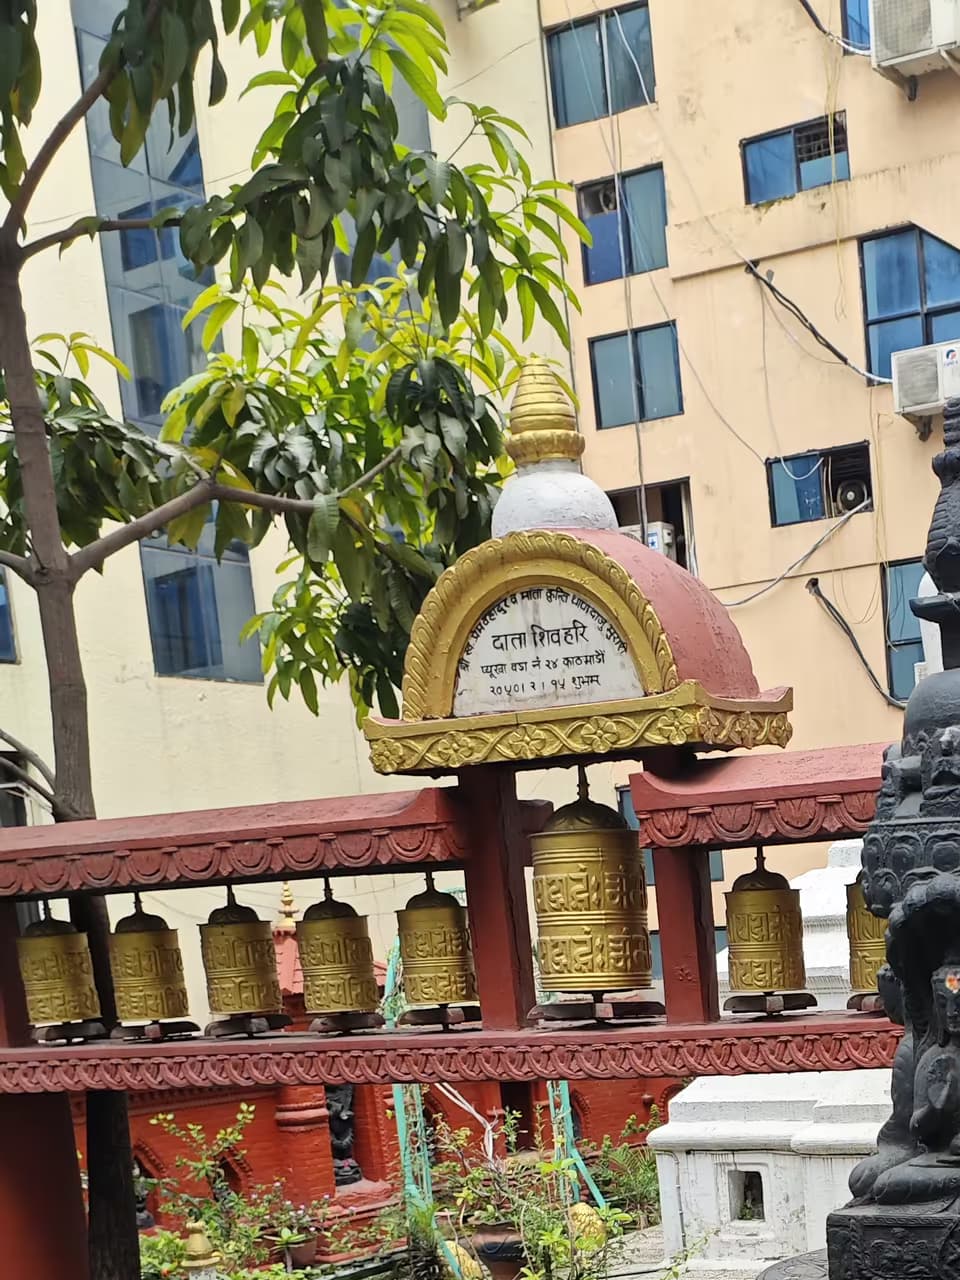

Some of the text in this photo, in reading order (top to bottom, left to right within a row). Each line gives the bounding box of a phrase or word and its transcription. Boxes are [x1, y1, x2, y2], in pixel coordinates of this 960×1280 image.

[520, 588, 544, 601] माता
[491, 619, 589, 652] दाता शिवहरि
[511, 661, 528, 673] वडा
[532, 656, 542, 670] नं
[545, 658, 559, 670] २४
[562, 649, 606, 669] काठमाडौं
